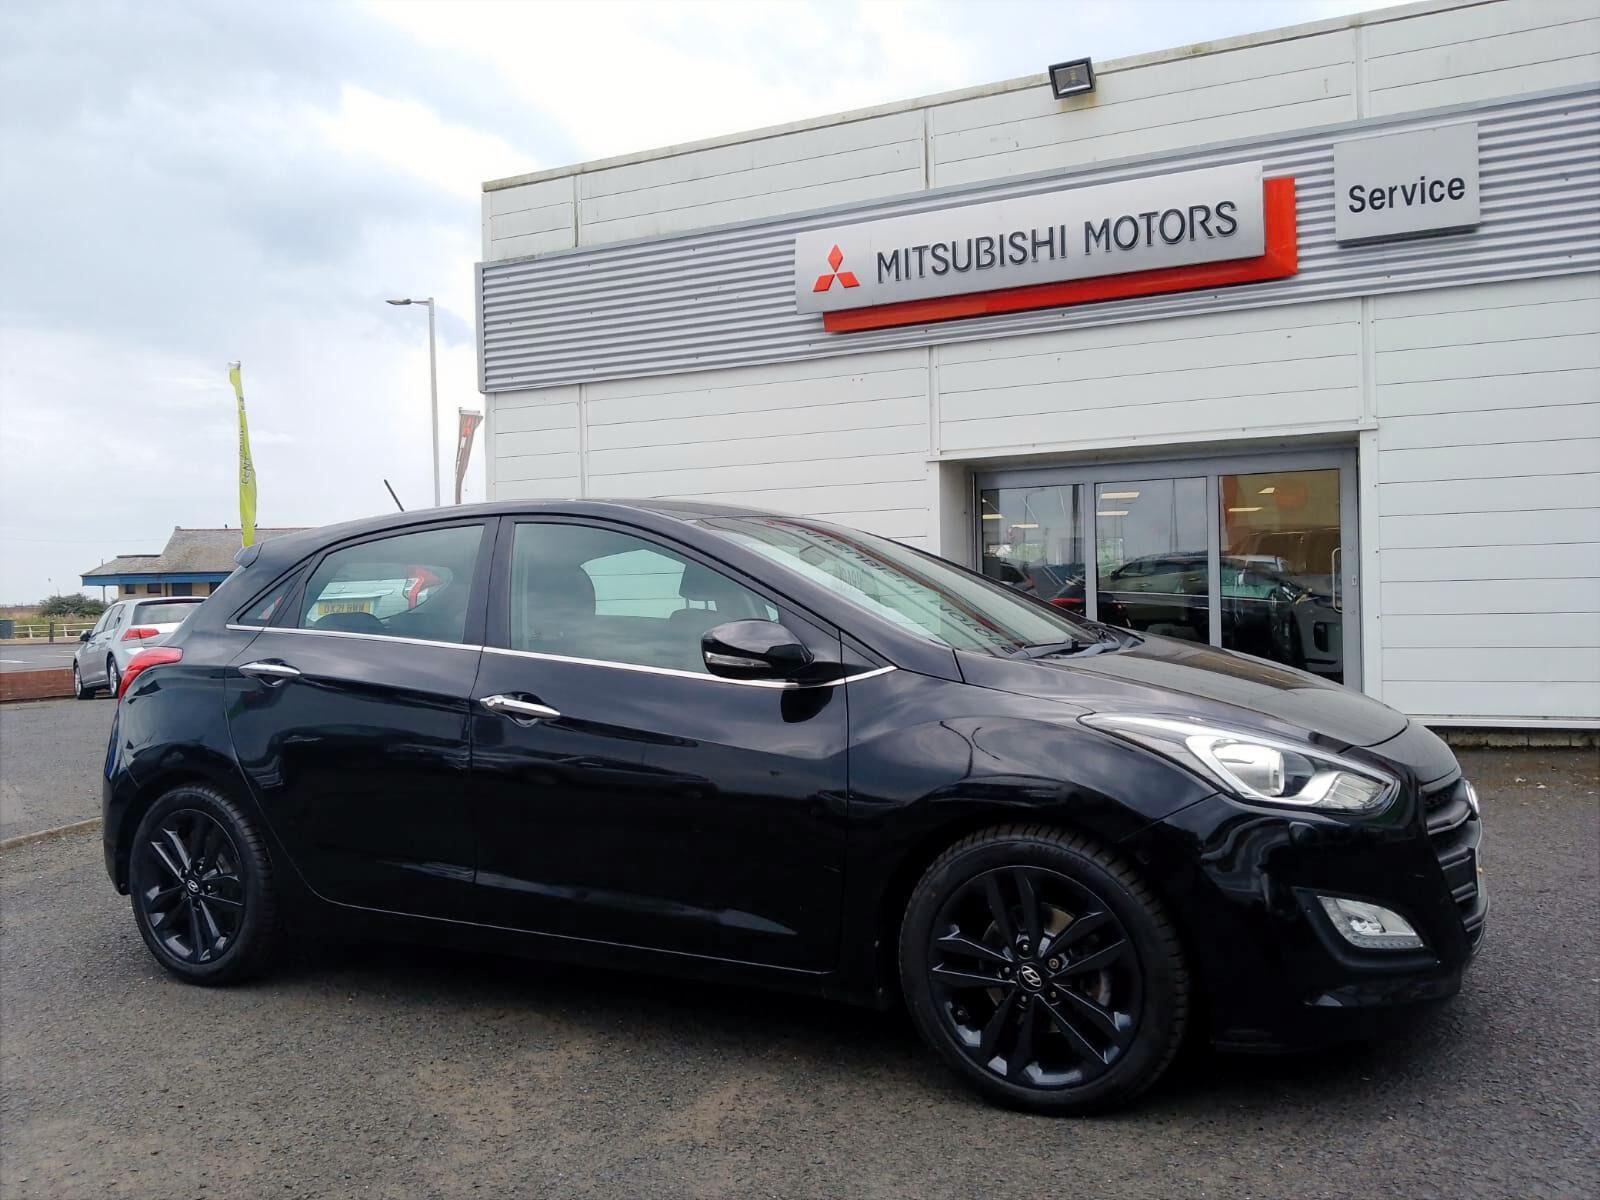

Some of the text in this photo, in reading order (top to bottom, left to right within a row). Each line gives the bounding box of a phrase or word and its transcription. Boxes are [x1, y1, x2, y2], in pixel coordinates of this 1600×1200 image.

[1348, 175, 1466, 213] Service
[877, 200, 1237, 284] MITSUBISHI MOTORS
